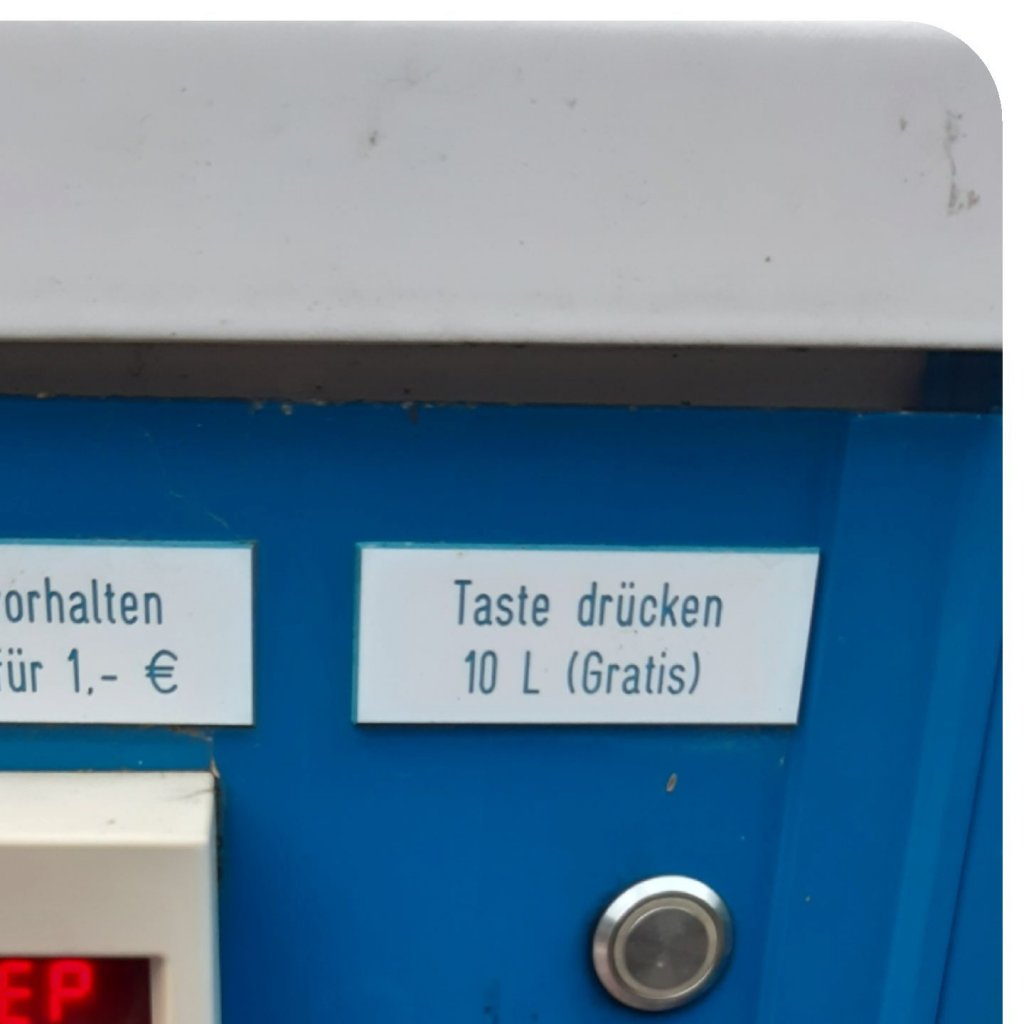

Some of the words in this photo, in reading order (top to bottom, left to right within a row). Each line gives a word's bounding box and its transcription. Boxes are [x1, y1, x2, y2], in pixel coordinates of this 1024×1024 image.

[453, 579, 551, 627] Taste
[577, 581, 724, 628] drücken
[67, 648, 118, 696] 1,-
[144, 649, 179, 694] €
[464, 650, 498, 694] 10
[522, 650, 540, 694] L
[567, 650, 702, 695] (Gratis)
